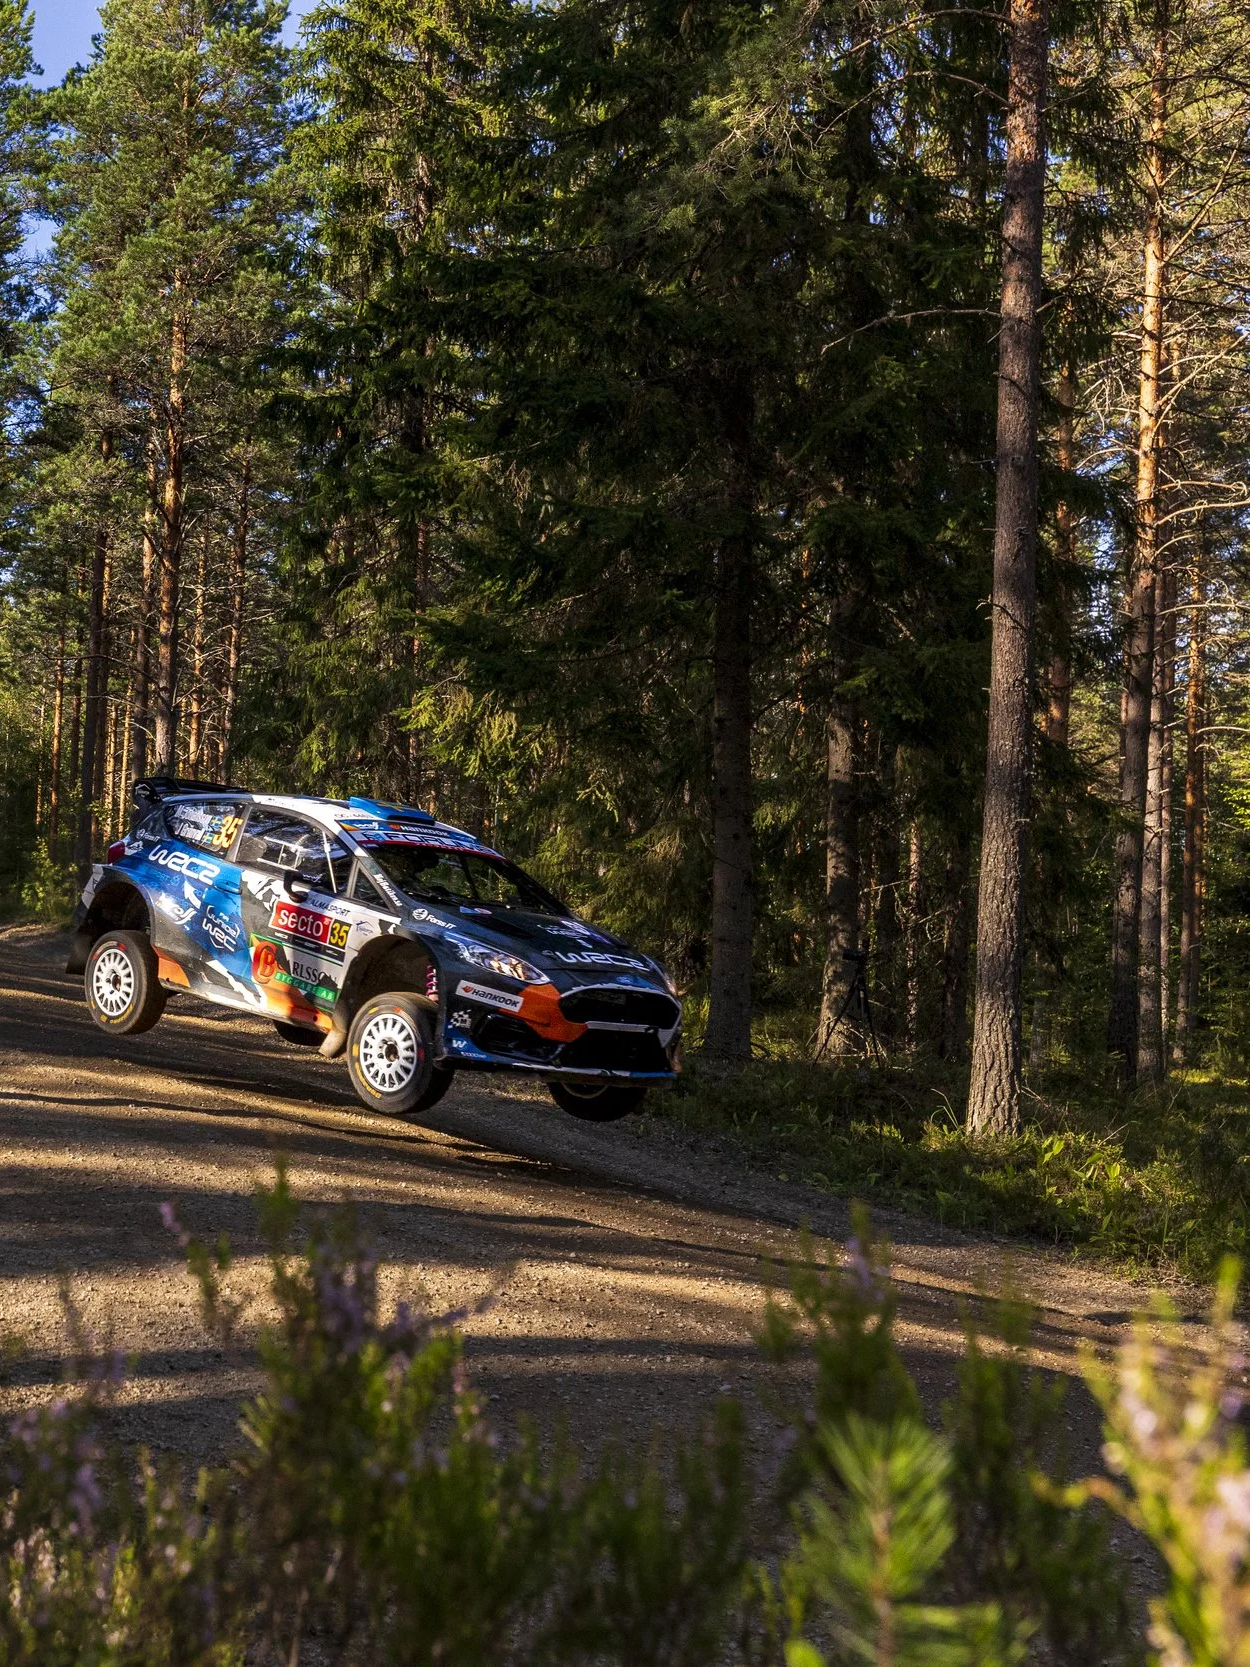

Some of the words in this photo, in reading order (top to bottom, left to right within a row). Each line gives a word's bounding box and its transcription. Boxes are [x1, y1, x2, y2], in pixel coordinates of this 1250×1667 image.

[212, 815, 244, 848] 35
[400, 825, 450, 838] HANKOOK
[148, 845, 220, 886] WRC2
[202, 918, 236, 952] WRC
[278, 909, 324, 937] secto
[330, 922, 350, 947] 35
[277, 958, 337, 985] RLSSO
[555, 951, 651, 972] WRC2
[275, 971, 317, 994] BYGGARE
[320, 988, 333, 1000] AB
[471, 988, 520, 1008] HANKOOK
